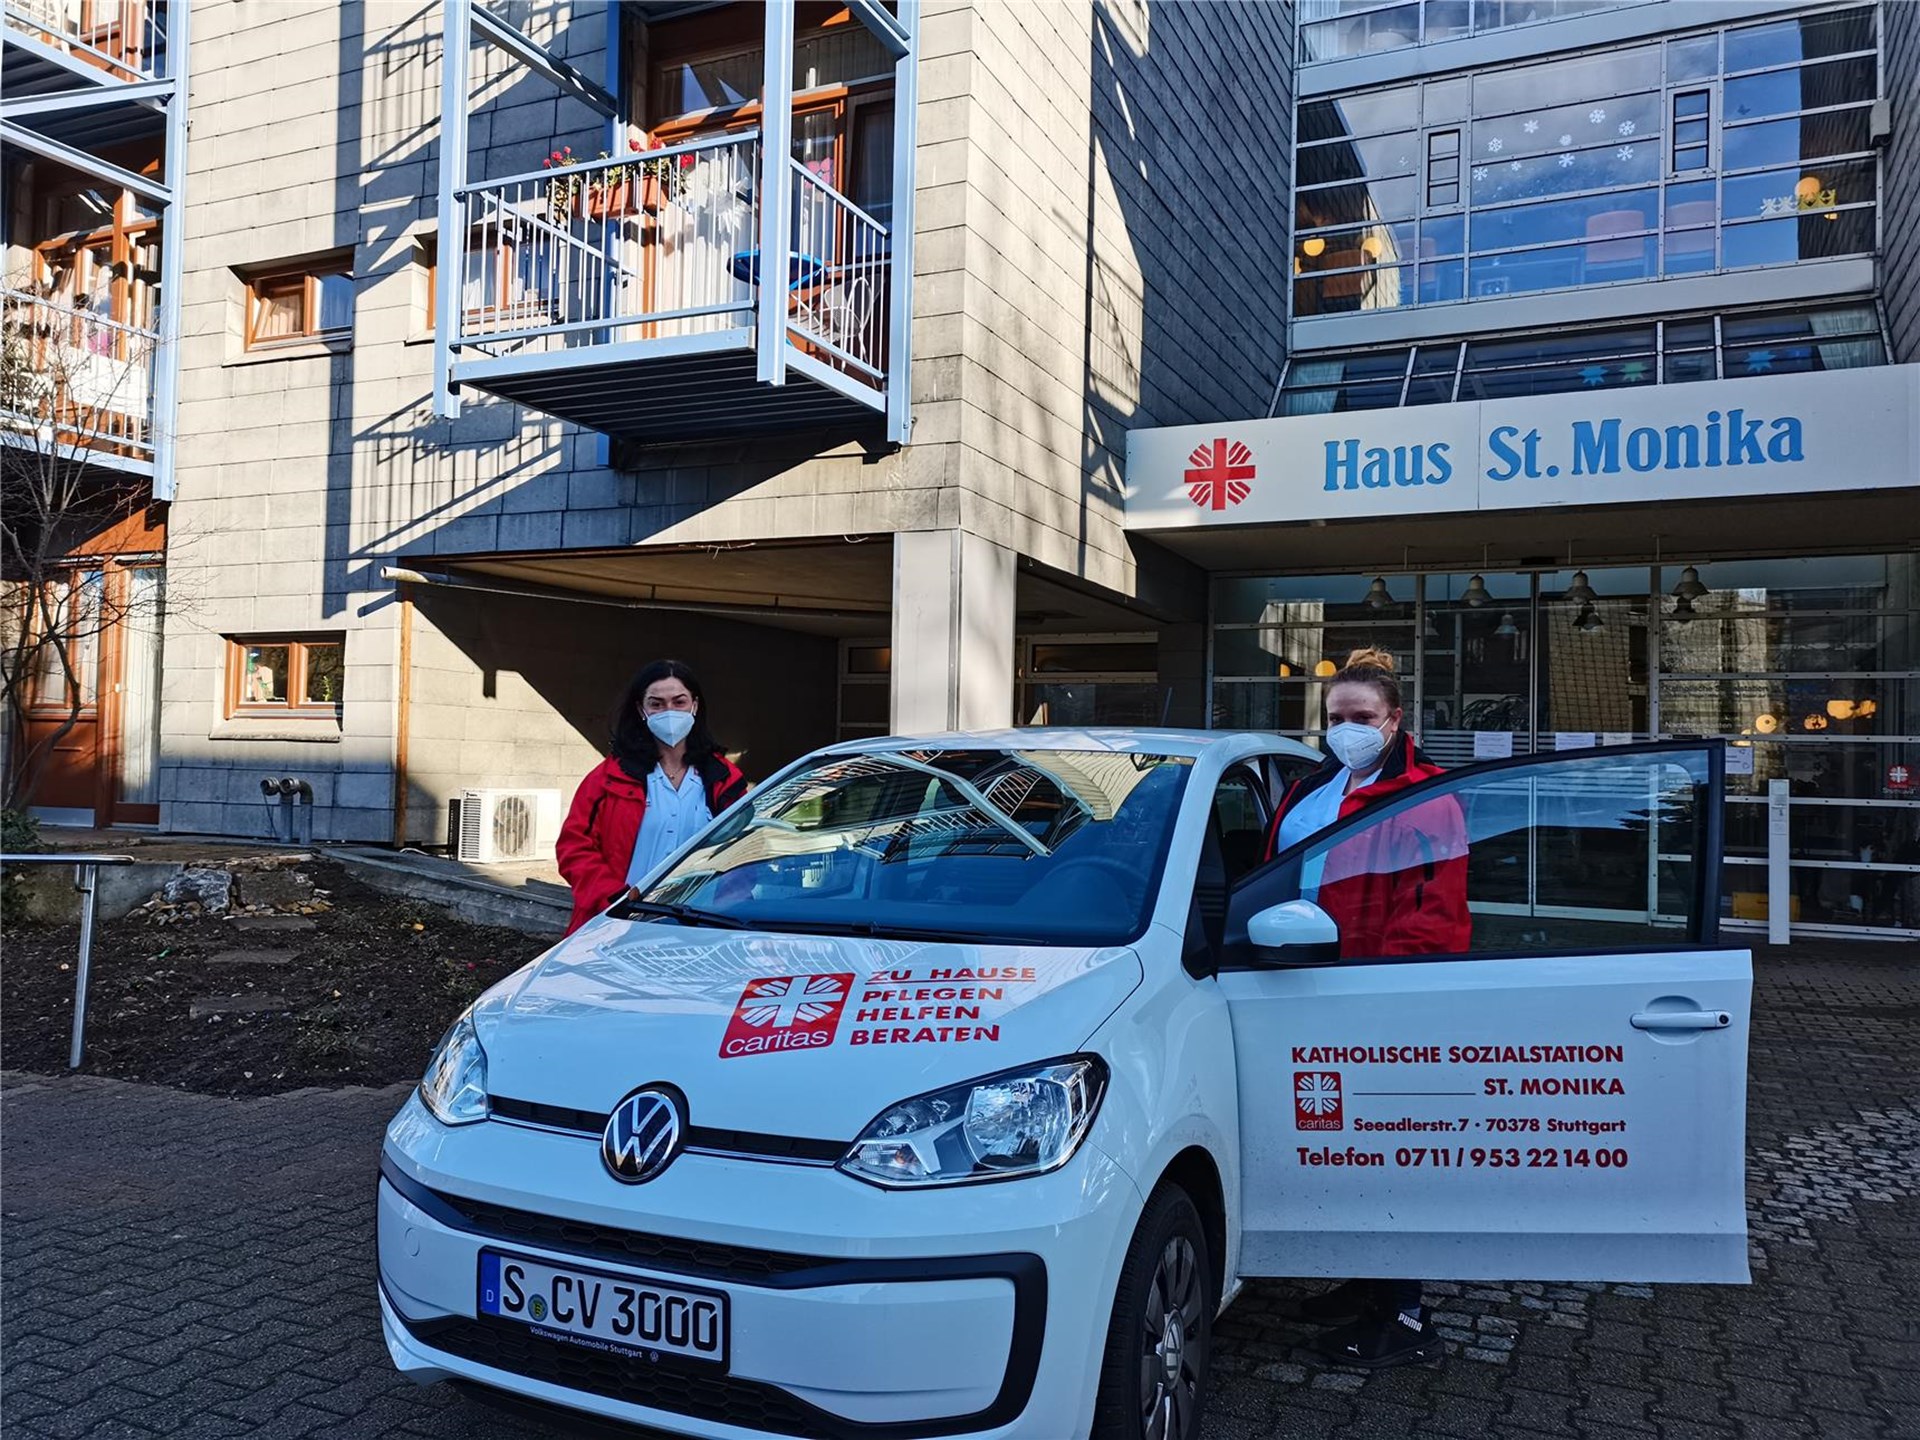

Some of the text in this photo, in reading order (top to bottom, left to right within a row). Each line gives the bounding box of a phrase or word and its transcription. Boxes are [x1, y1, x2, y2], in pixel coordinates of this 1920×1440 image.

[1323, 409, 1804, 491] Haus St. Monika
[867, 967, 1036, 982] ZU HAUSE
[862, 987, 1004, 1003] PFLEGEN
[855, 1006, 980, 1022] HELFEN
[726, 1029, 829, 1055] caritas
[849, 1024, 1000, 1046] BERATEN
[1291, 1045, 1624, 1064] KATHOLISCHE SOZIALSTATION
[1483, 1078, 1626, 1096] ST. MONIKA
[1298, 1116, 1341, 1130] caritas
[1485, 1118, 1541, 1132] 70378
[1547, 1118, 1627, 1135] Stuttgart
[1297, 1146, 1385, 1167] Telefon
[486, 1288, 495, 1303] D
[502, 1264, 718, 1353] S CV 3000
[1397, 1311, 1423, 1333] PUMA
[529, 1325, 569, 1342] Volkswagen
[569, 1336, 609, 1351] Automobile
[609, 1344, 643, 1359] Stuttgart
